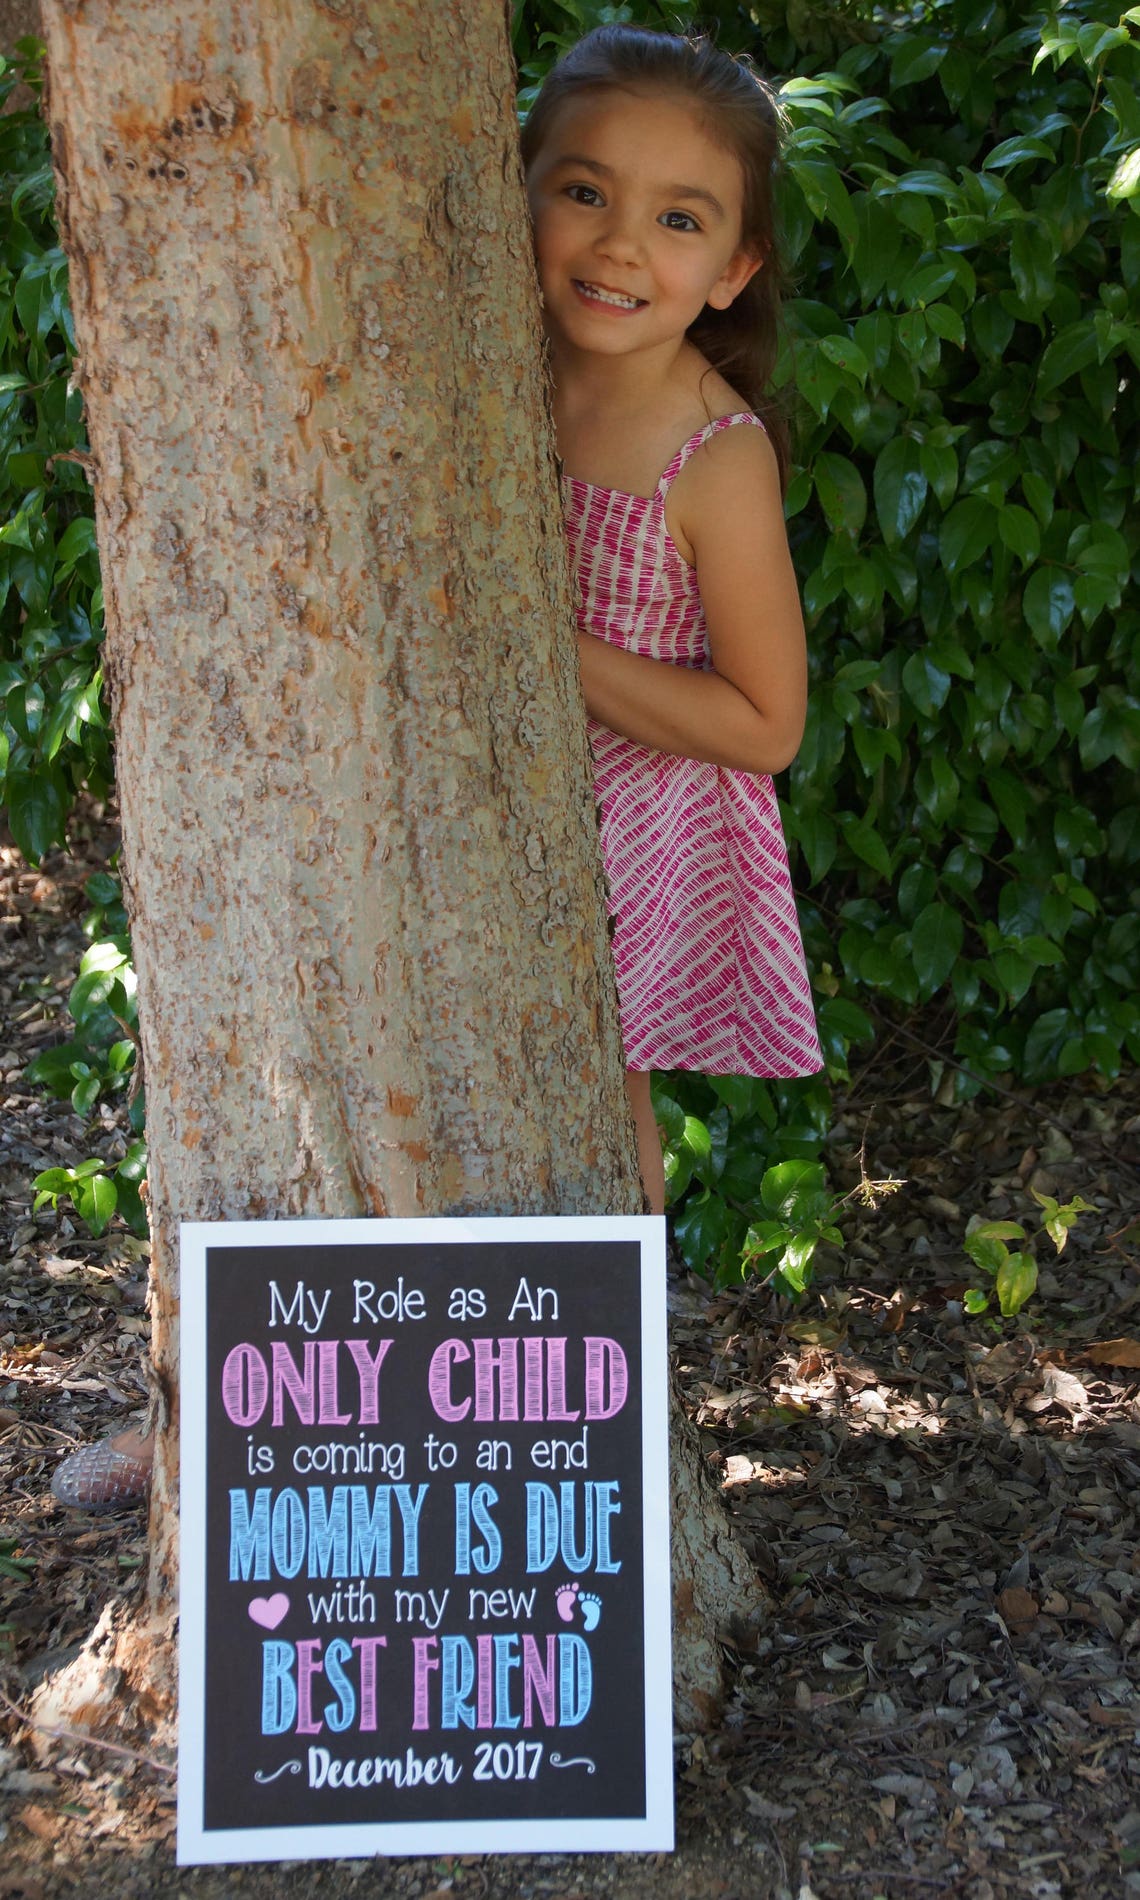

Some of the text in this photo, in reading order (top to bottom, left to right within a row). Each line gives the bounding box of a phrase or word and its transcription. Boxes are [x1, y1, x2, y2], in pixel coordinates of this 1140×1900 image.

[268, 1276, 559, 1334] My Role as An
[222, 1336, 629, 1427] ONLY CHILD
[247, 1425, 588, 1481] is coming to an end
[228, 1480, 622, 1582] MOMMY IS DUE
[307, 1580, 536, 1630] with my new
[261, 1632, 593, 1736] BEST FRIEND
[308, 1740, 544, 1789] December 2017
